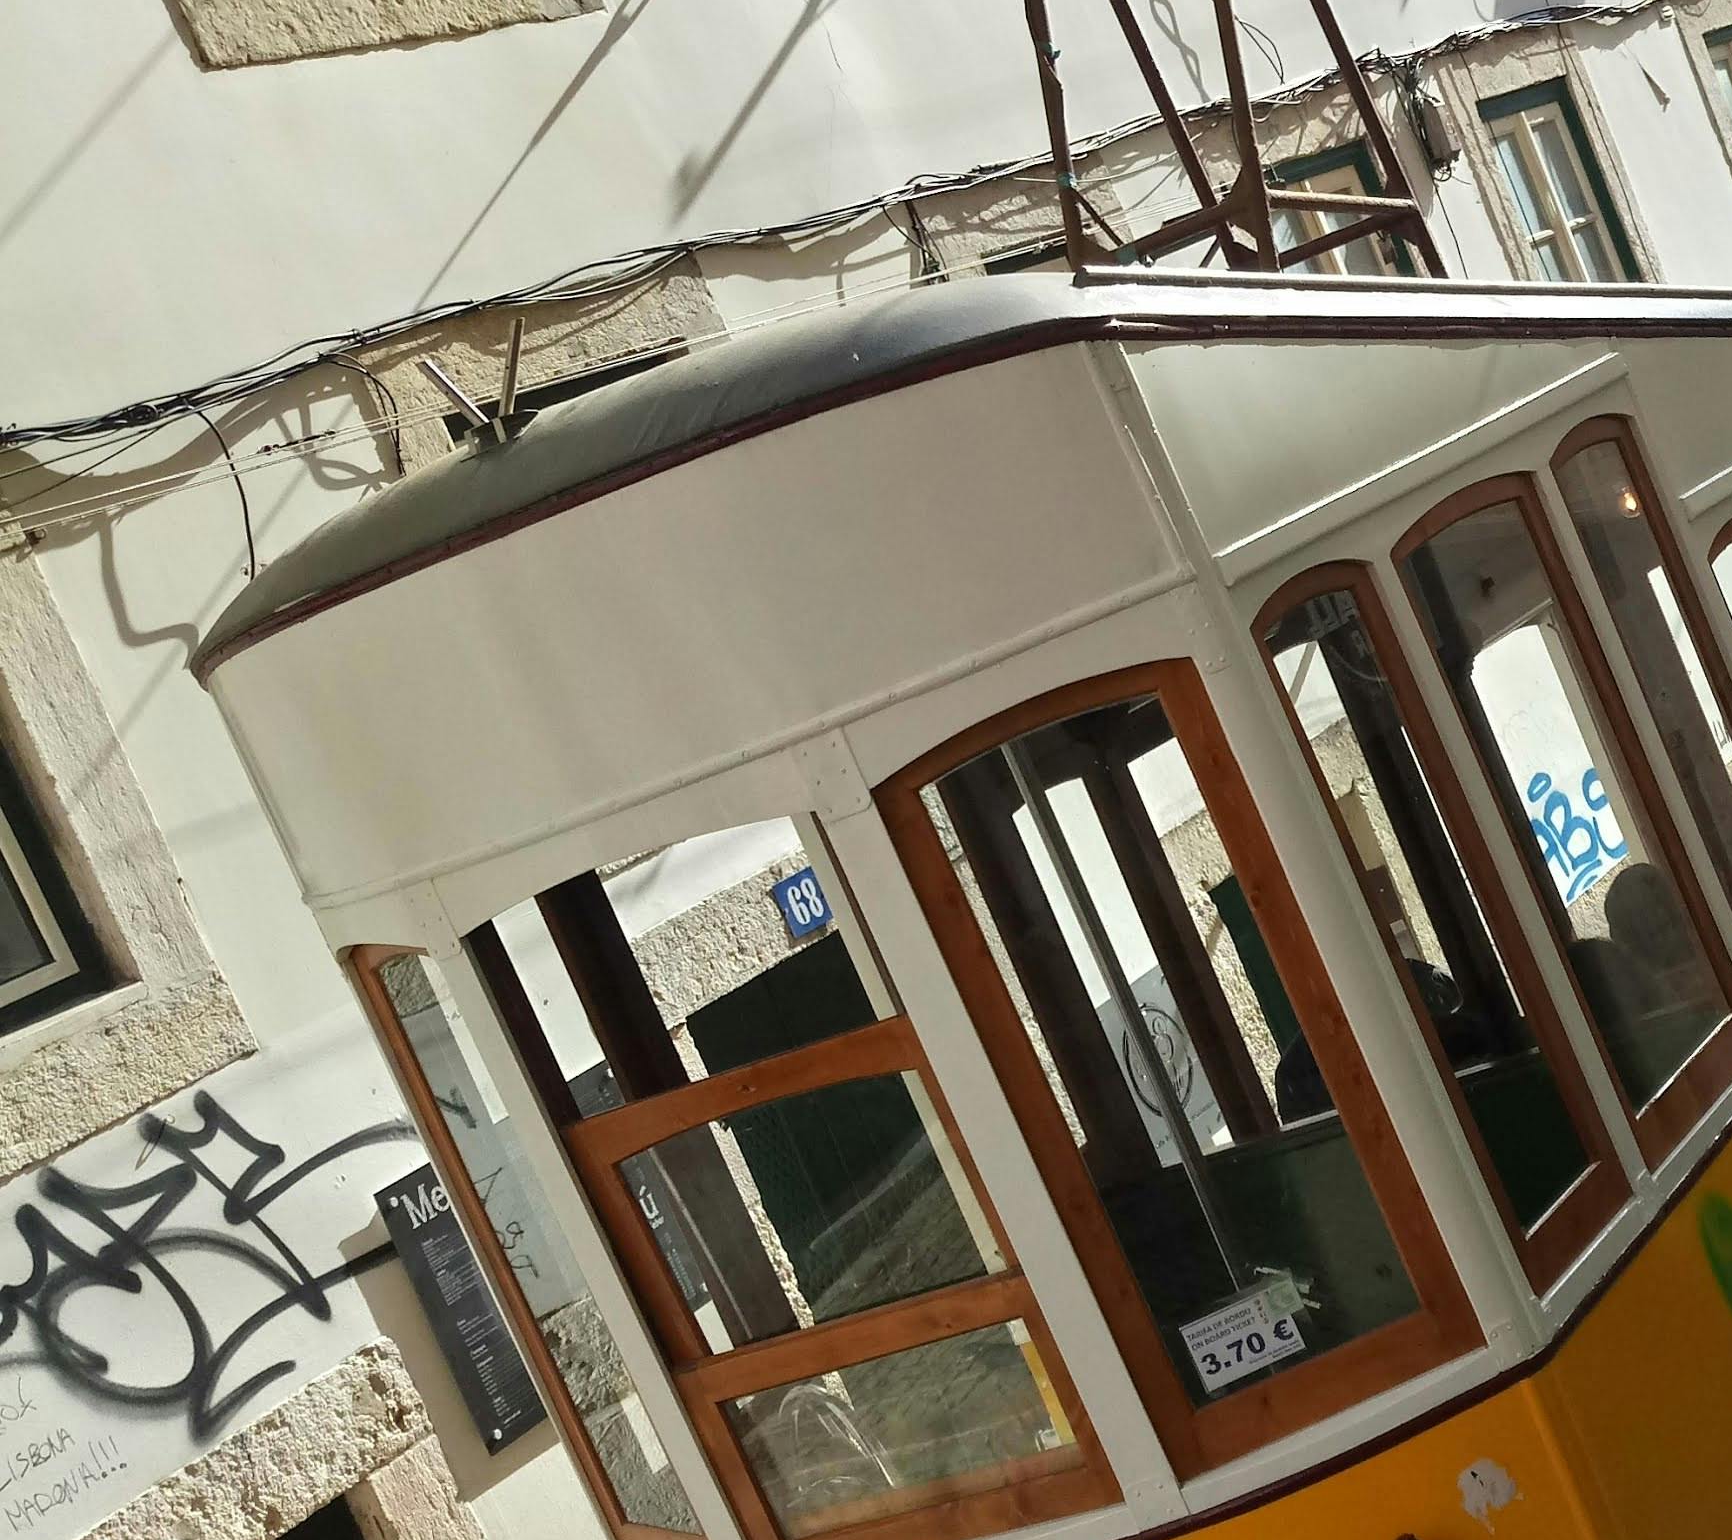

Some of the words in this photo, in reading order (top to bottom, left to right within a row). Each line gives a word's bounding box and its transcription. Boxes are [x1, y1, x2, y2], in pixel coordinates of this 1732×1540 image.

[787, 878, 824, 926] 68
[1201, 1332, 1266, 1375] 3.70
[1273, 1319, 1294, 1341] €
[1204, 1328, 1232, 1346] BOARD
[1231, 1316, 1257, 1332] TICKET
